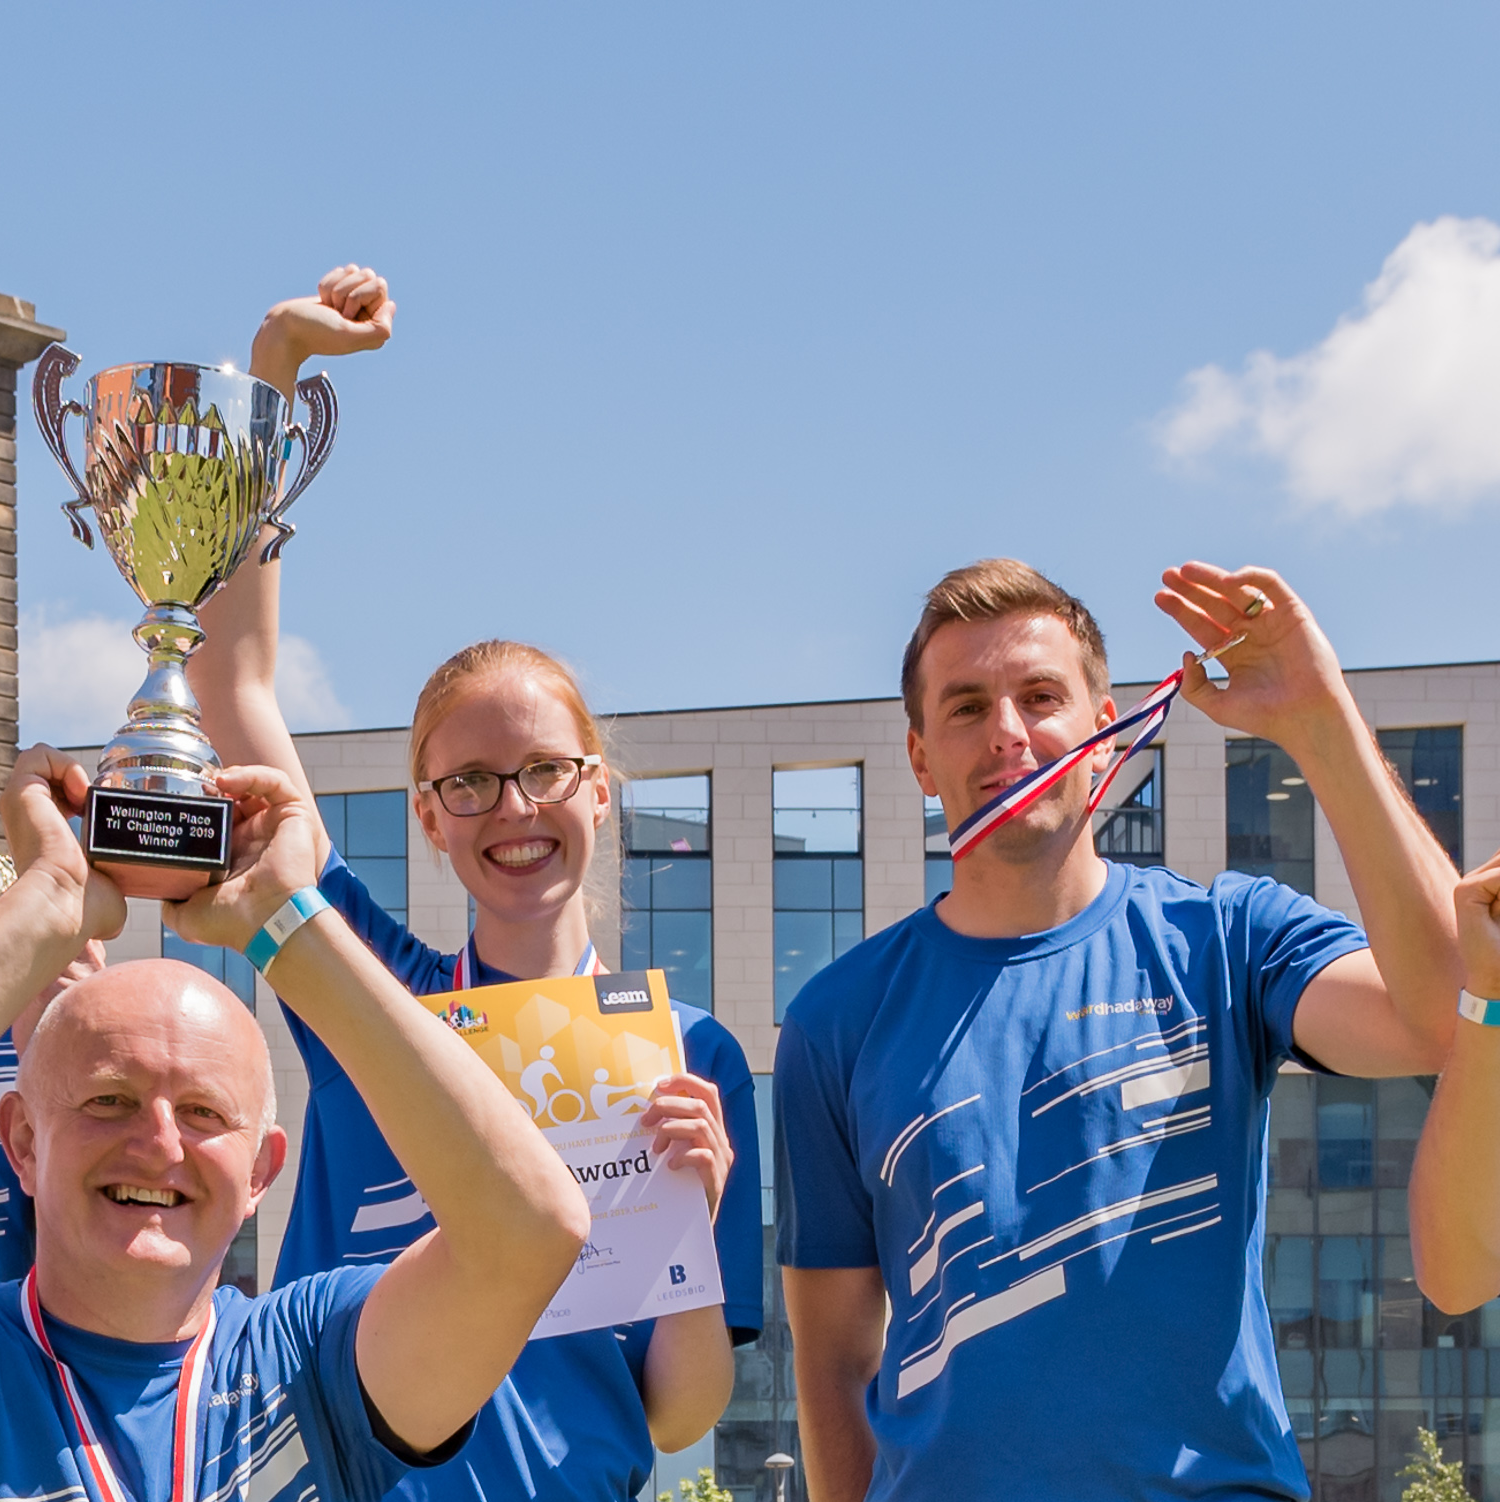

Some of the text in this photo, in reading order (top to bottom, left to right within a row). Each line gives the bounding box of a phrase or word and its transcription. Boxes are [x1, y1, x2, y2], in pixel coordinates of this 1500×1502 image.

[110, 805, 211, 825] Wellington Place
[106, 818, 215, 839] Tri Challenge 2019
[138, 834, 180, 847] Winner
[1065, 995, 1173, 1021] wardhadaway
[568, 1138, 592, 1149] HAVE
[594, 1134, 618, 1144] BEEN
[545, 1308, 572, 1320] Place
